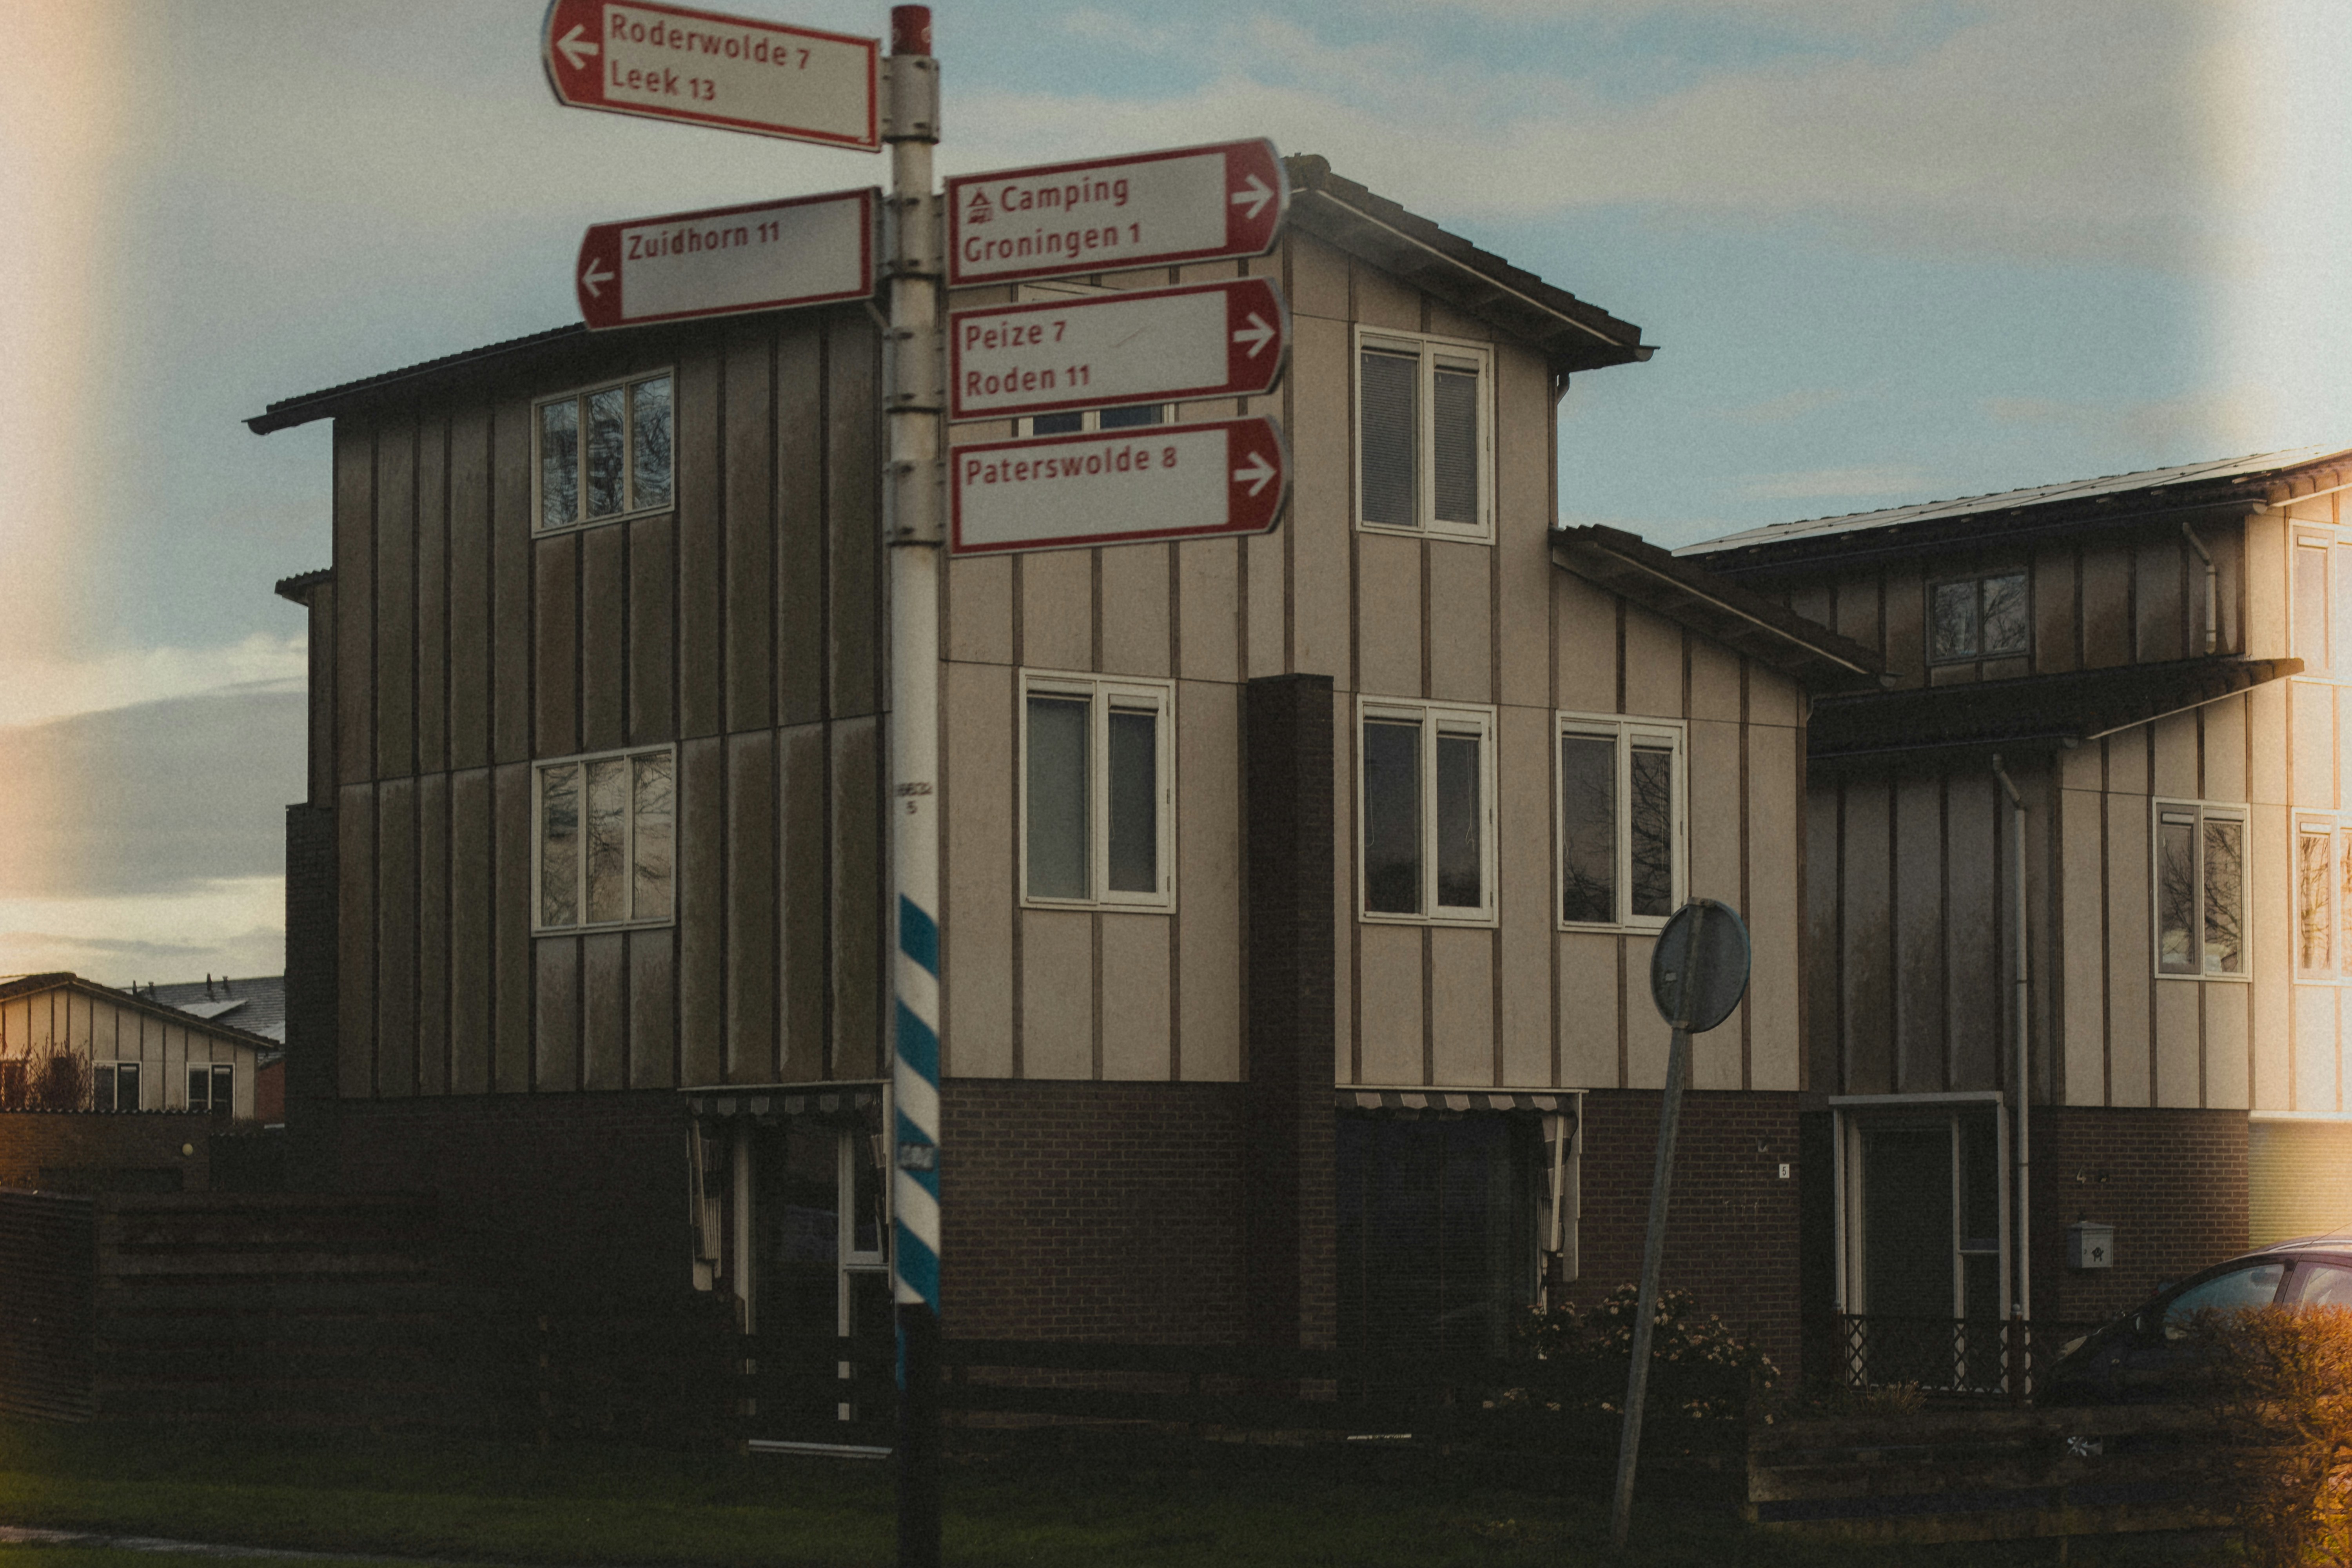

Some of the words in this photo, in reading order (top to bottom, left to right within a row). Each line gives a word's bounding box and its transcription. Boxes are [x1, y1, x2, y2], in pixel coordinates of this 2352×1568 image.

[611, 13, 787, 66] Roderwolde
[796, 47, 811, 70] 7
[611, 60, 679, 96] Leek
[689, 78, 716, 102] 13
[1000, 177, 1128, 212] Camping
[628, 227, 748, 260] Zuidhorn
[758, 221, 780, 243] 11
[964, 226, 1119, 263] Groningen
[1128, 222, 1140, 244] 1
[965, 321, 1042, 351] Peize
[1053, 320, 1067, 343] 7
[966, 367, 1055, 397] Roden
[1065, 365, 1090, 387] 11
[965, 445, 1149, 485] Paterswolde
[1162, 446, 1177, 468] 8
[1782, 1166, 1787, 1176] 5
[2076, 1165, 2087, 1184] 4
